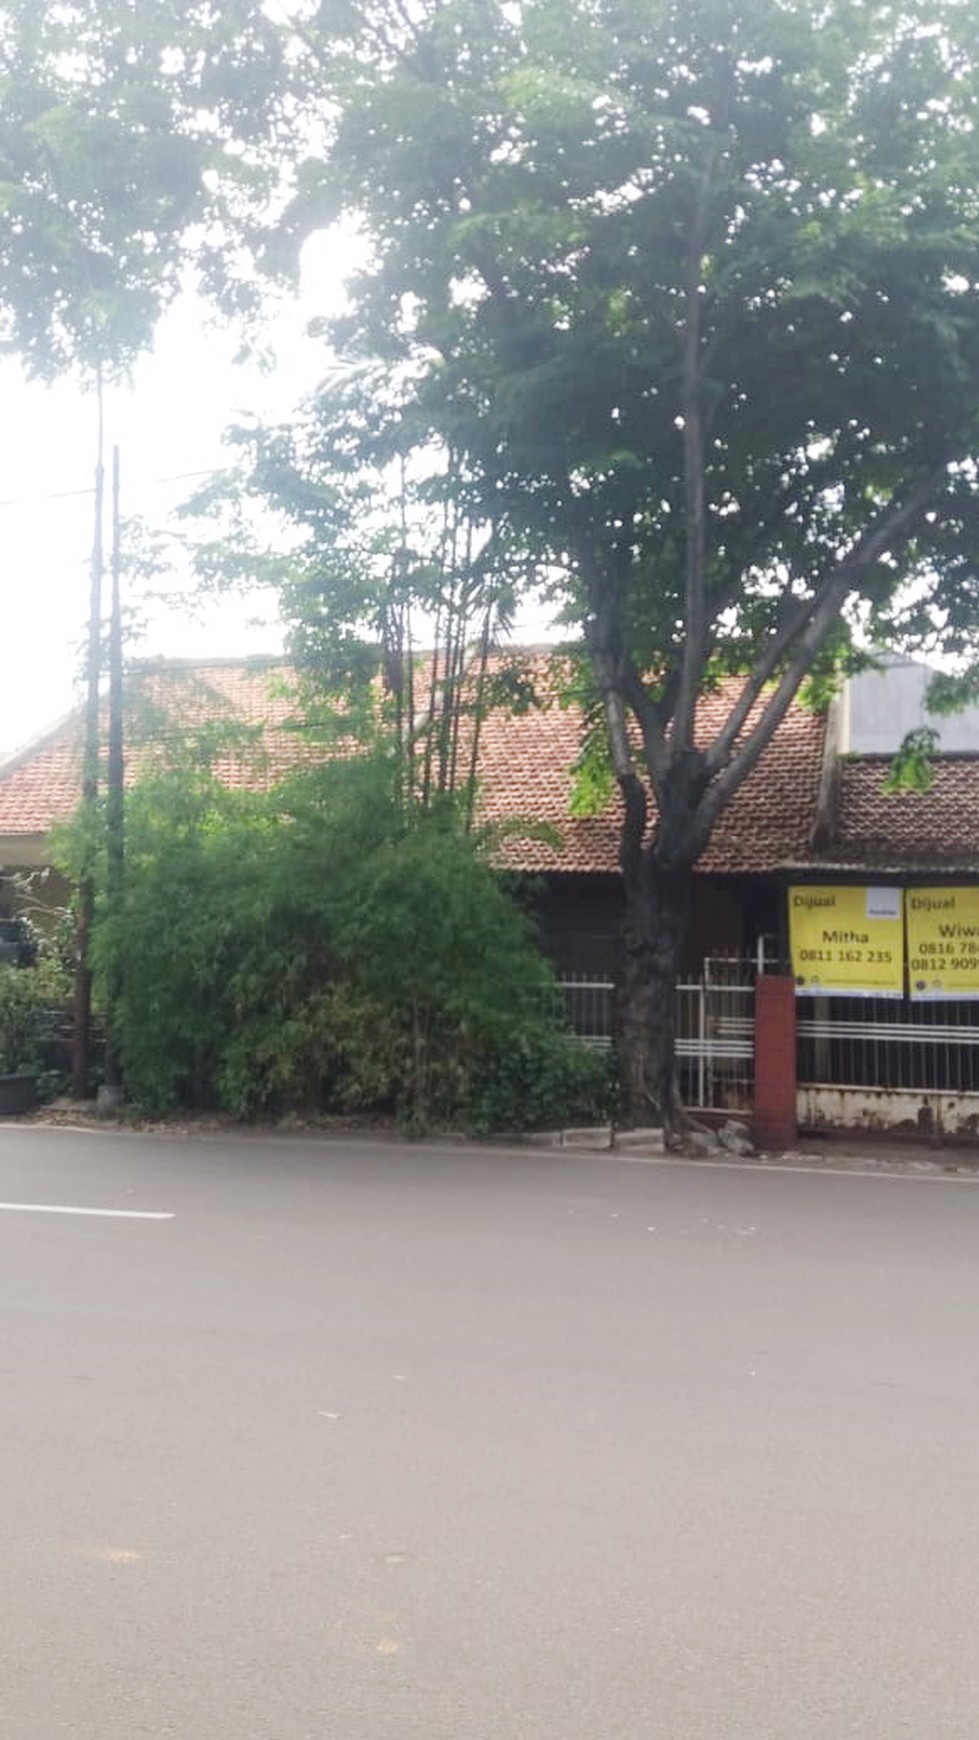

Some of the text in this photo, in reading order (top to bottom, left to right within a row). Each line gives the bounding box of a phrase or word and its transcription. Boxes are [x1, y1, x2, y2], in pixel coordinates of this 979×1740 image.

[793, 895, 836, 909] Dijual
[912, 896, 955, 912] Dijual
[822, 930, 869, 943] Mitha
[800, 949, 892, 963] 0811 162 235
[911, 958, 946, 971] 0812
